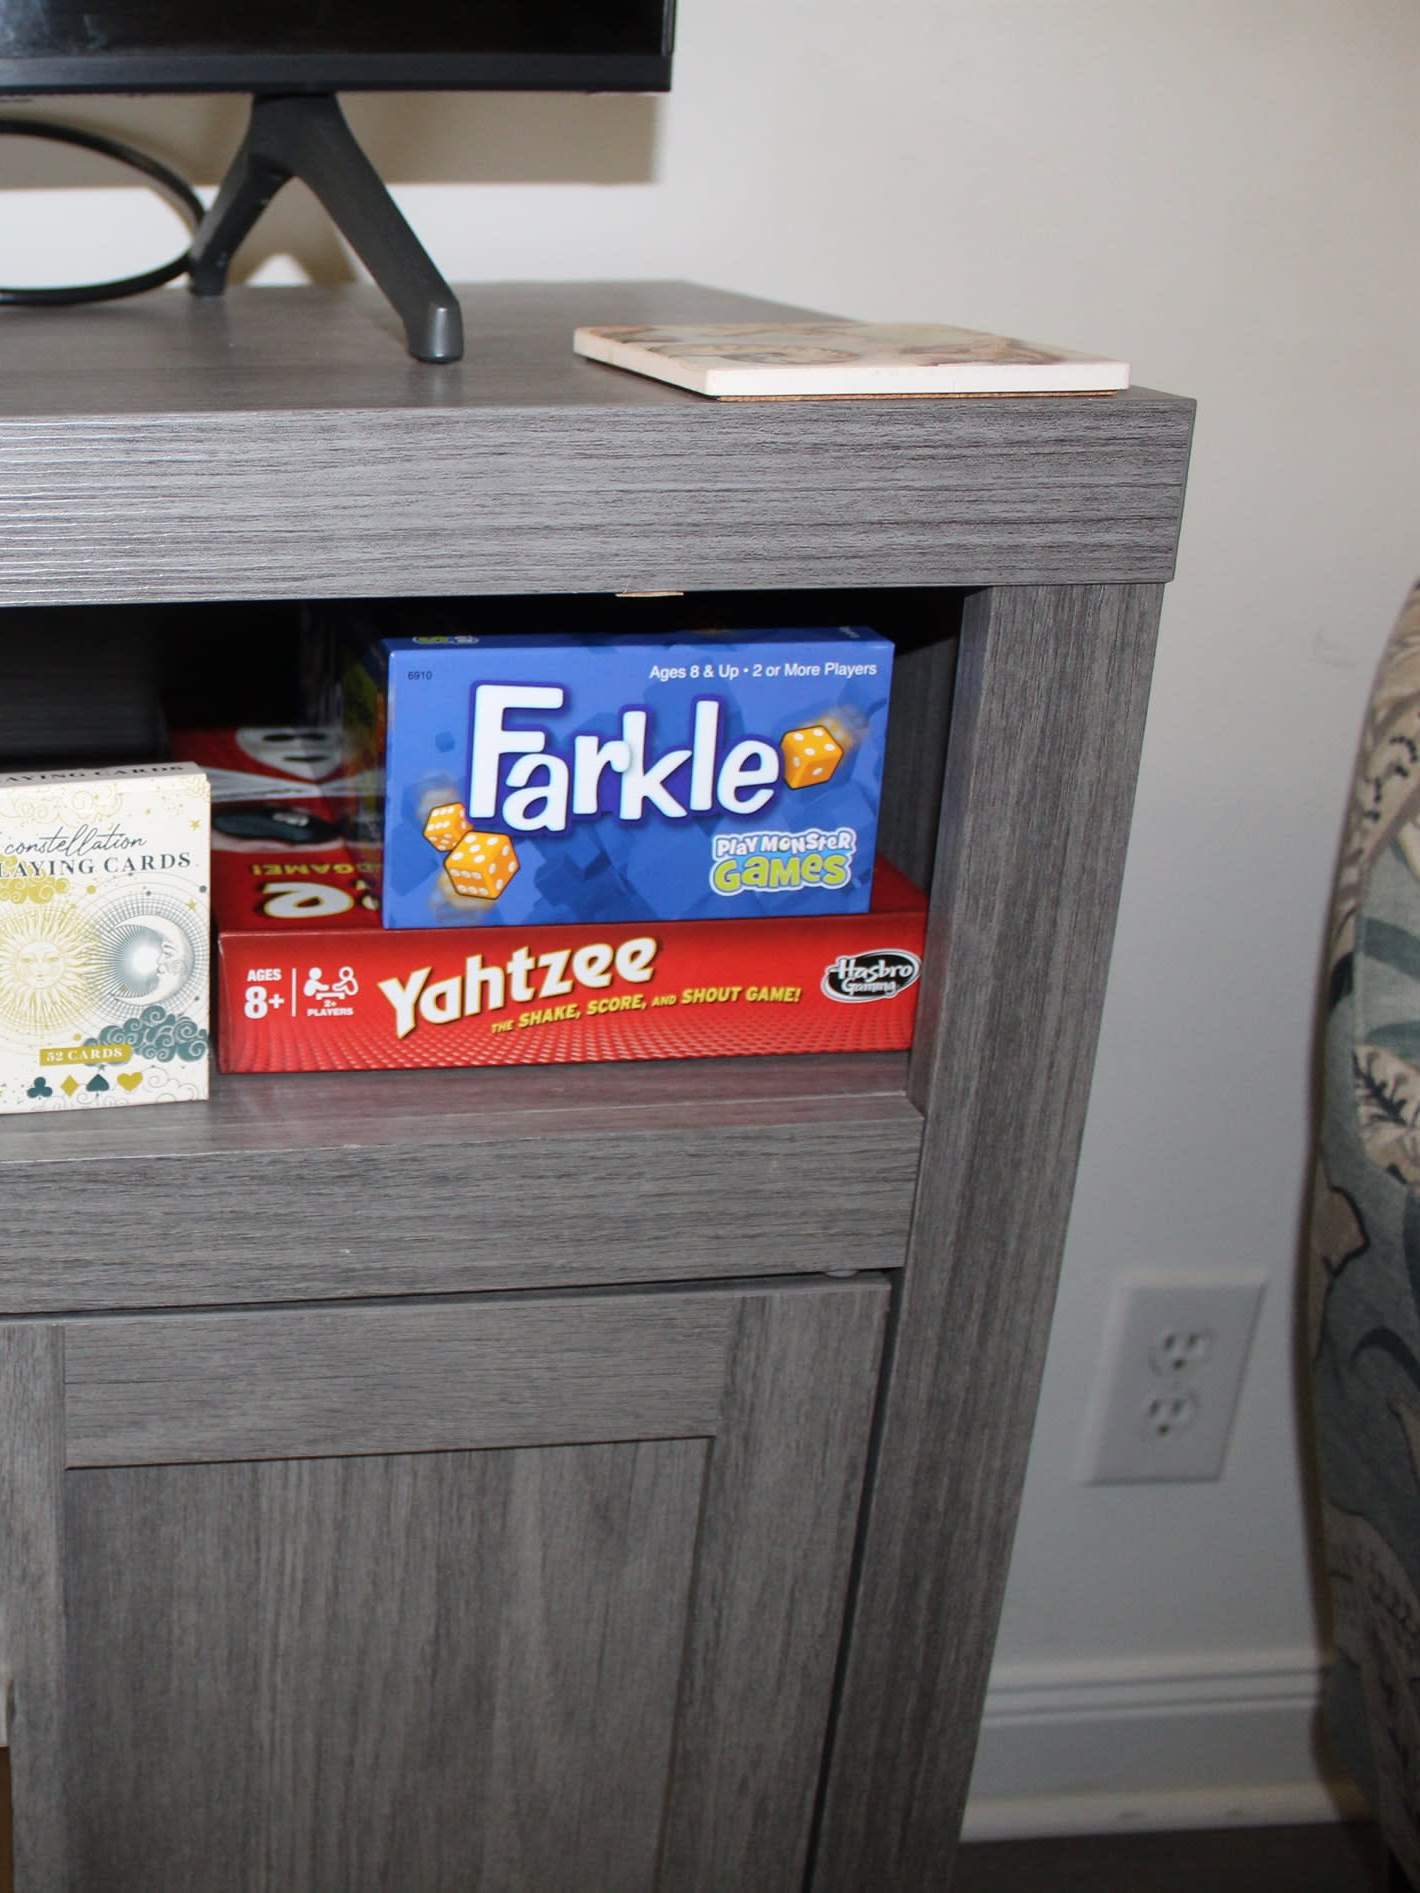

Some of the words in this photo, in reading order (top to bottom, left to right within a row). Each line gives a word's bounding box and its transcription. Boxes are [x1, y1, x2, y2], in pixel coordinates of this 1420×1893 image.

[407, 671, 434, 680] 6910
[649, 665, 687, 682] Ages
[690, 665, 700, 678] 8
[703, 665, 714, 678] &
[718, 664, 740, 681] Up
[752, 664, 763, 677] 2
[766, 666, 781, 677] or
[784, 663, 821, 677] More
[824, 662, 878, 679] Players
[467, 684, 781, 832] Farkle
[4, 823, 147, 858] constellation
[104, 852, 192, 874] CARDS
[246, 968, 283, 982] AGES
[829, 958, 914, 983] Hasbro
[377, 936, 660, 1040] Yahtzee
[841, 978, 897, 996] Gaming
[244, 985, 285, 1019] 8+
[306, 1007, 355, 1017] PLAYERS
[491, 1020, 514, 1034] THE
[518, 1003, 582, 1029] SHAKE,
[586, 994, 647, 1016] SCORE,
[652, 995, 677, 1007] AND
[681, 987, 743, 1004] SHOUT
[745, 986, 803, 1003] GAME!
[45, 1051, 63, 1062] 52
[67, 1047, 123, 1061] CARDS
